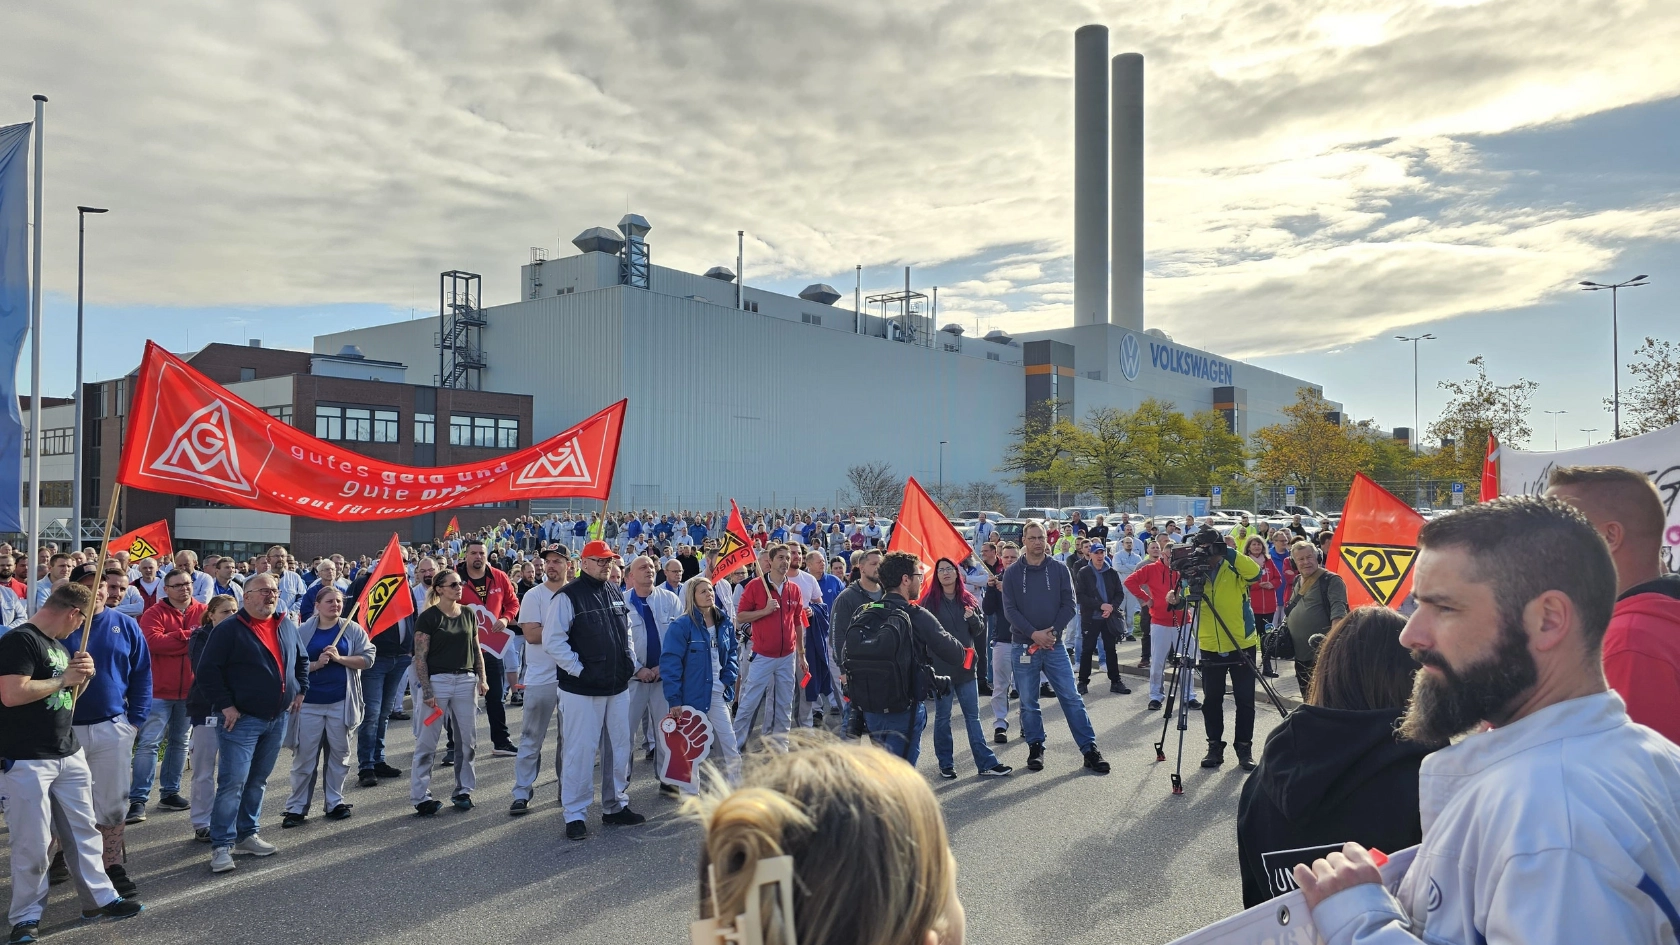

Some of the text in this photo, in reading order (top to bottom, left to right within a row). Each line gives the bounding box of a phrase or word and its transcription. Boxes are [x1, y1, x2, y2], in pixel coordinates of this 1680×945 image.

[1150, 342, 1232, 385] VOLKSWAGEN
[291, 445, 369, 477] gutes
[457, 461, 508, 482] und
[338, 480, 409, 500] gute
[337, 504, 372, 514] für
[376, 505, 420, 514] land
[1274, 867, 1295, 892] UN
